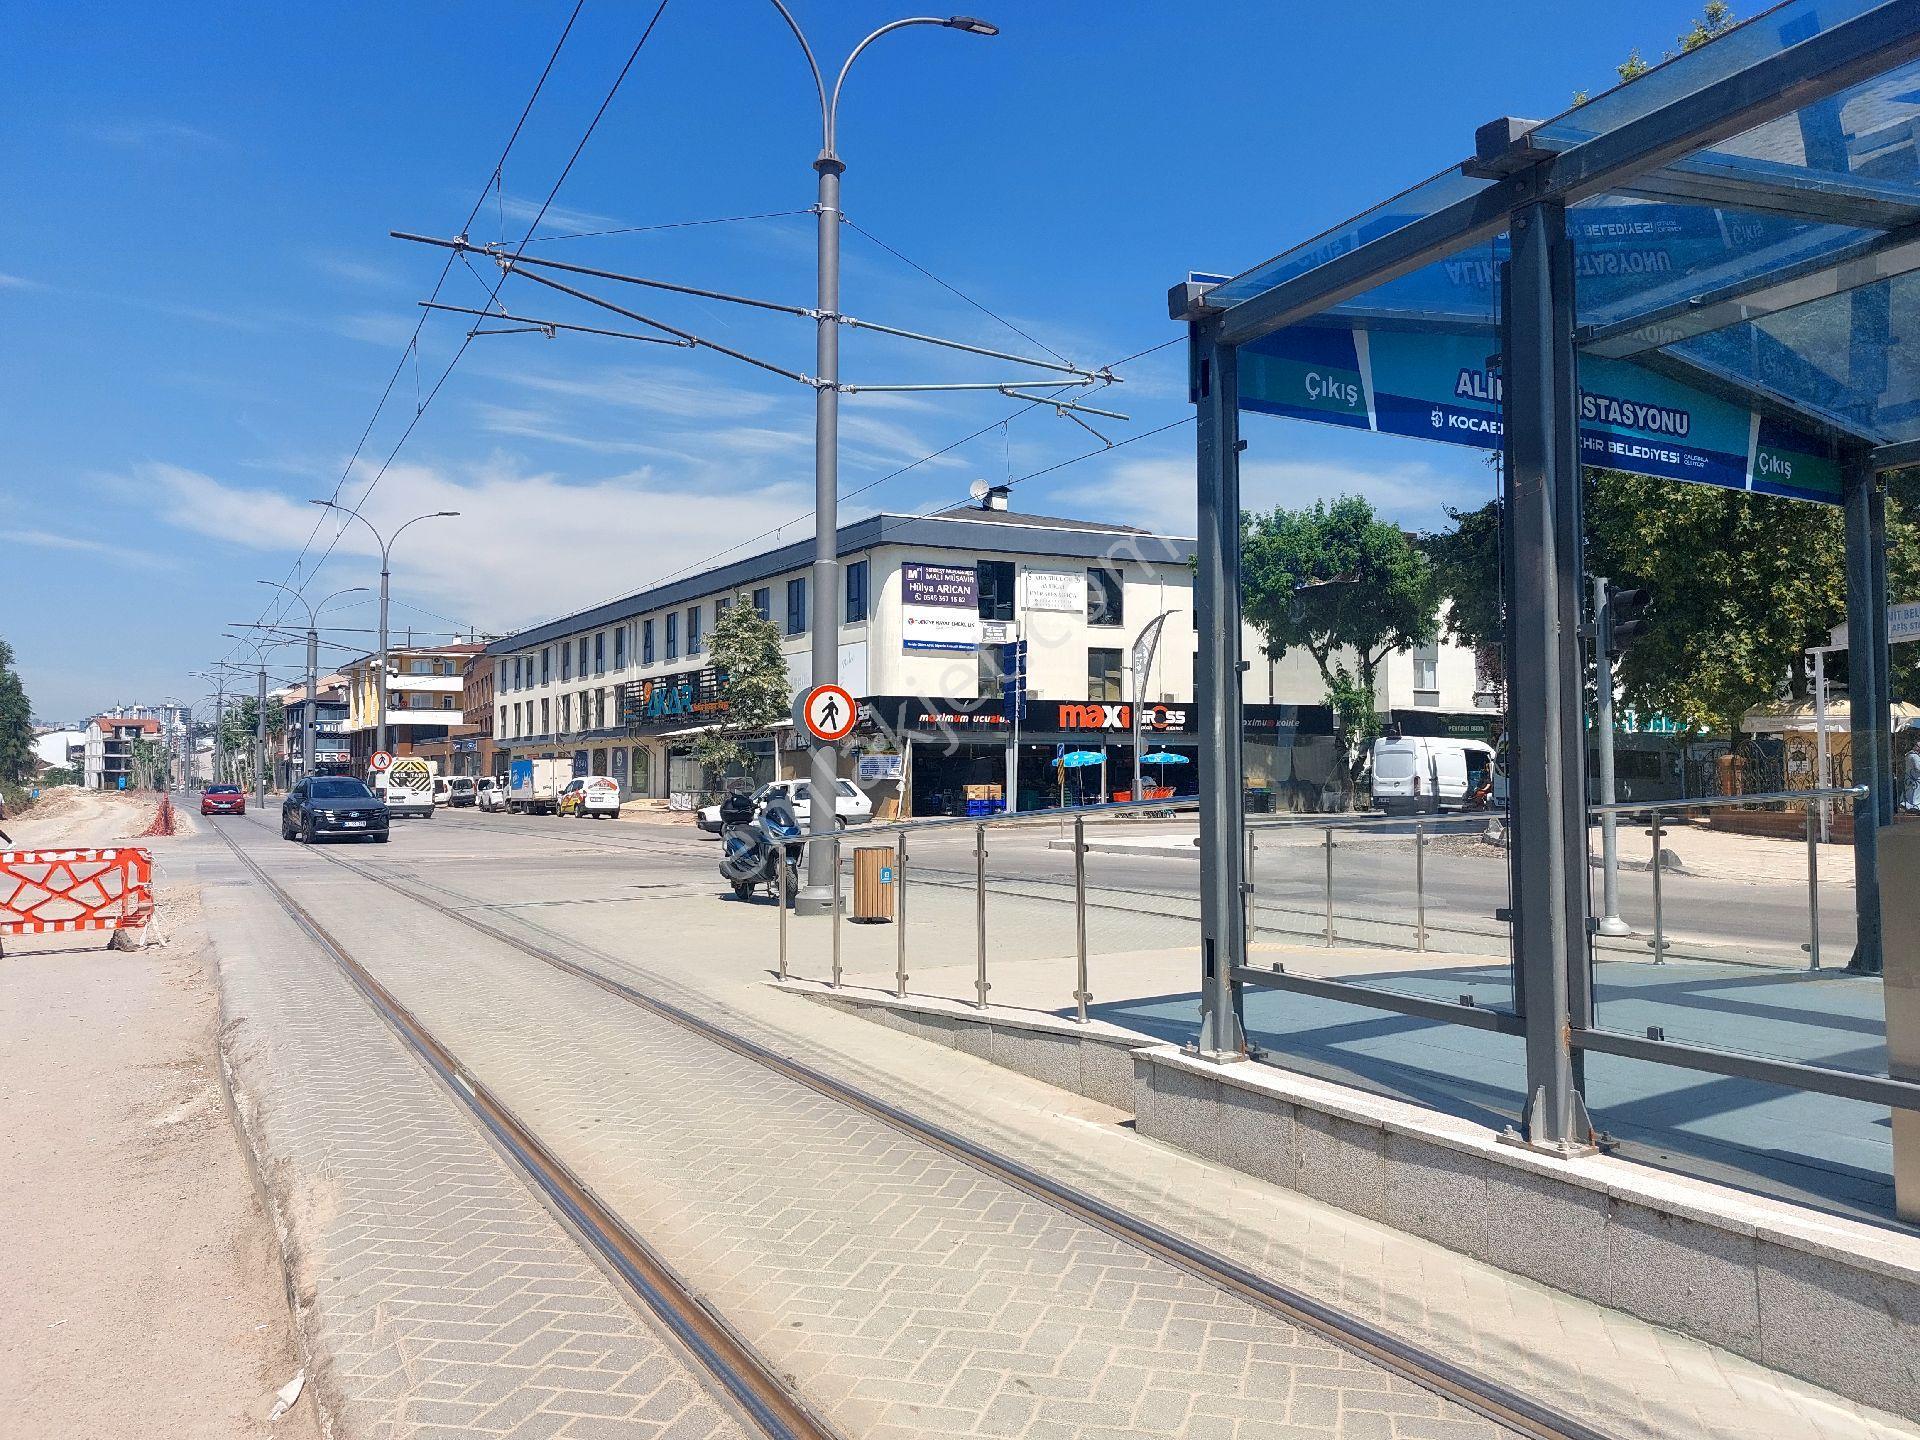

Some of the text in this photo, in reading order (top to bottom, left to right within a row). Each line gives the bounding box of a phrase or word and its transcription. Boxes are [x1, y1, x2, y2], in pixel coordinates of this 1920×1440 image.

[1305, 372, 1358, 407] Çıkış
[1758, 452, 1792, 479] Çıkış
[909, 582, 971, 595] Hülya ARICAN
[918, 713, 969, 723] maximum
[1058, 704, 1131, 729] maxi
